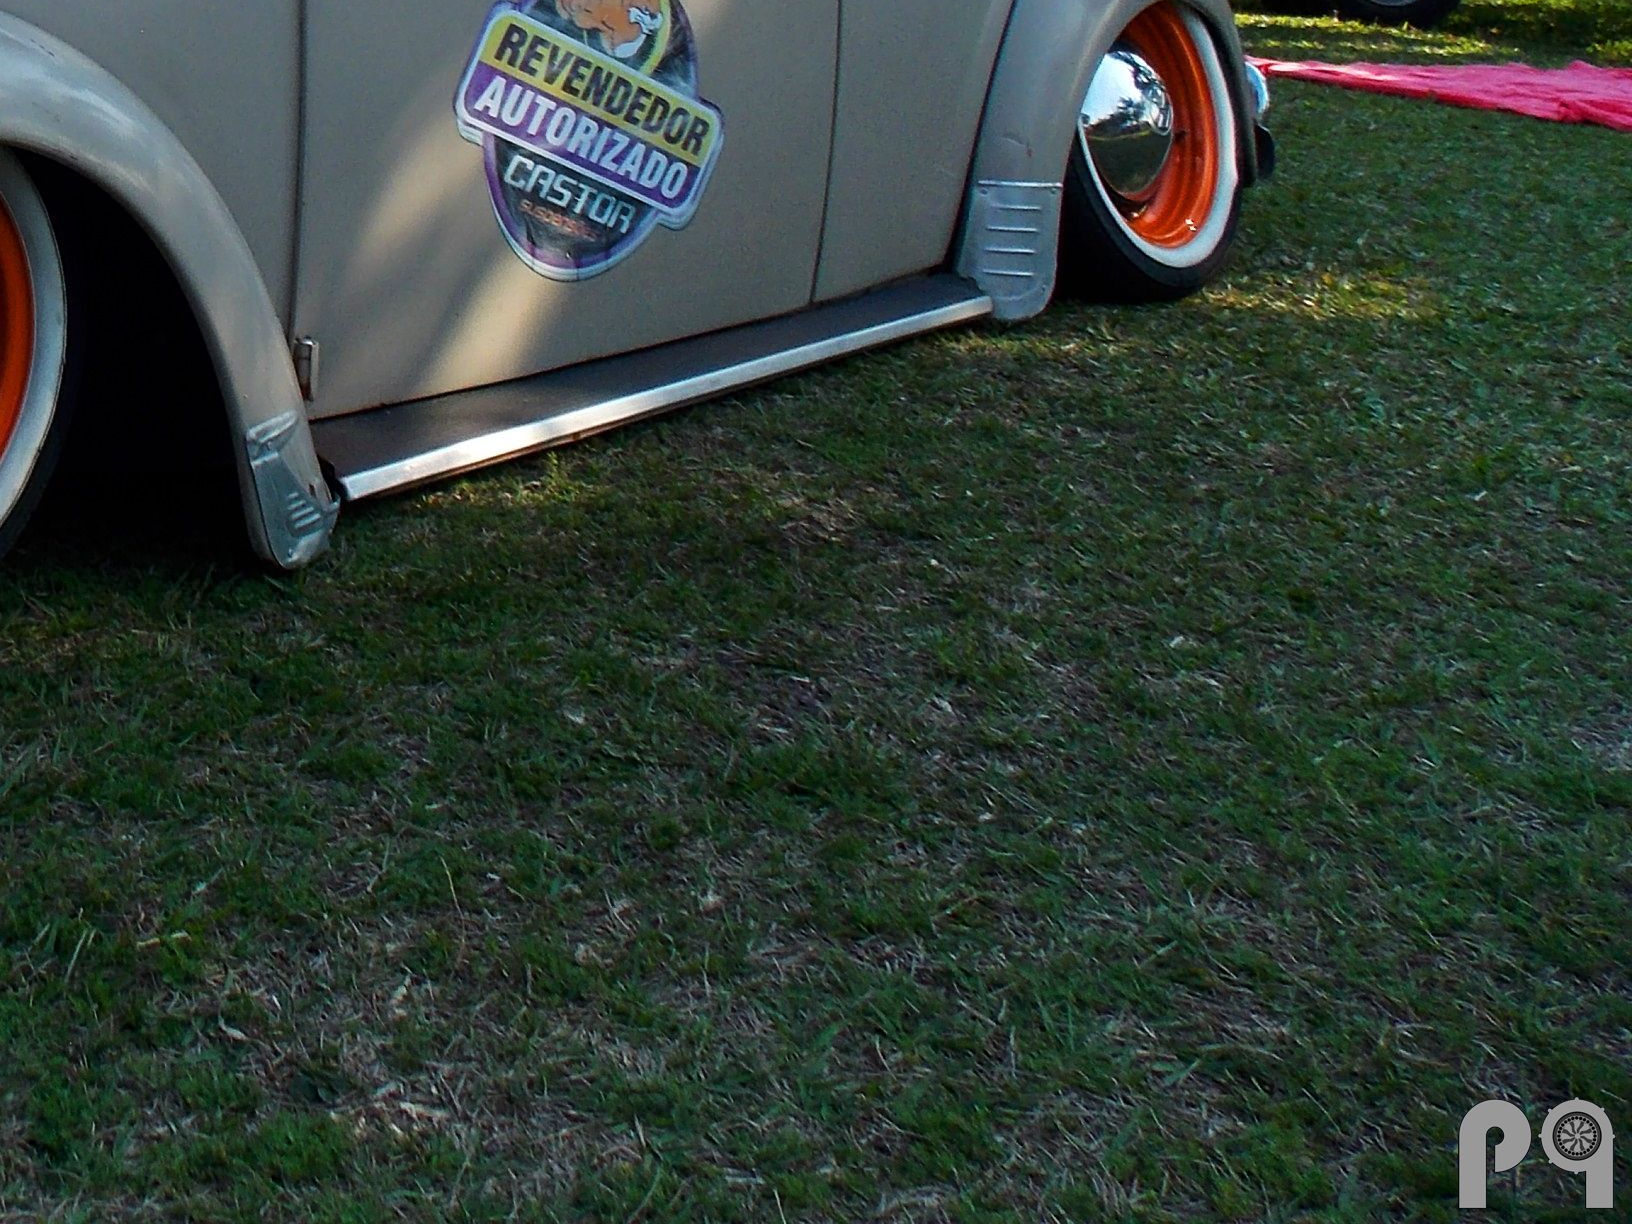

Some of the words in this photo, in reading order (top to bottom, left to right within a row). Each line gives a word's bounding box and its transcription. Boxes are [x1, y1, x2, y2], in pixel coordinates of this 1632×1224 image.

[474, 77, 688, 199] AUTORIZADO
[494, 23, 710, 156] REVENDEDOR
[503, 155, 636, 233] CASTOR
